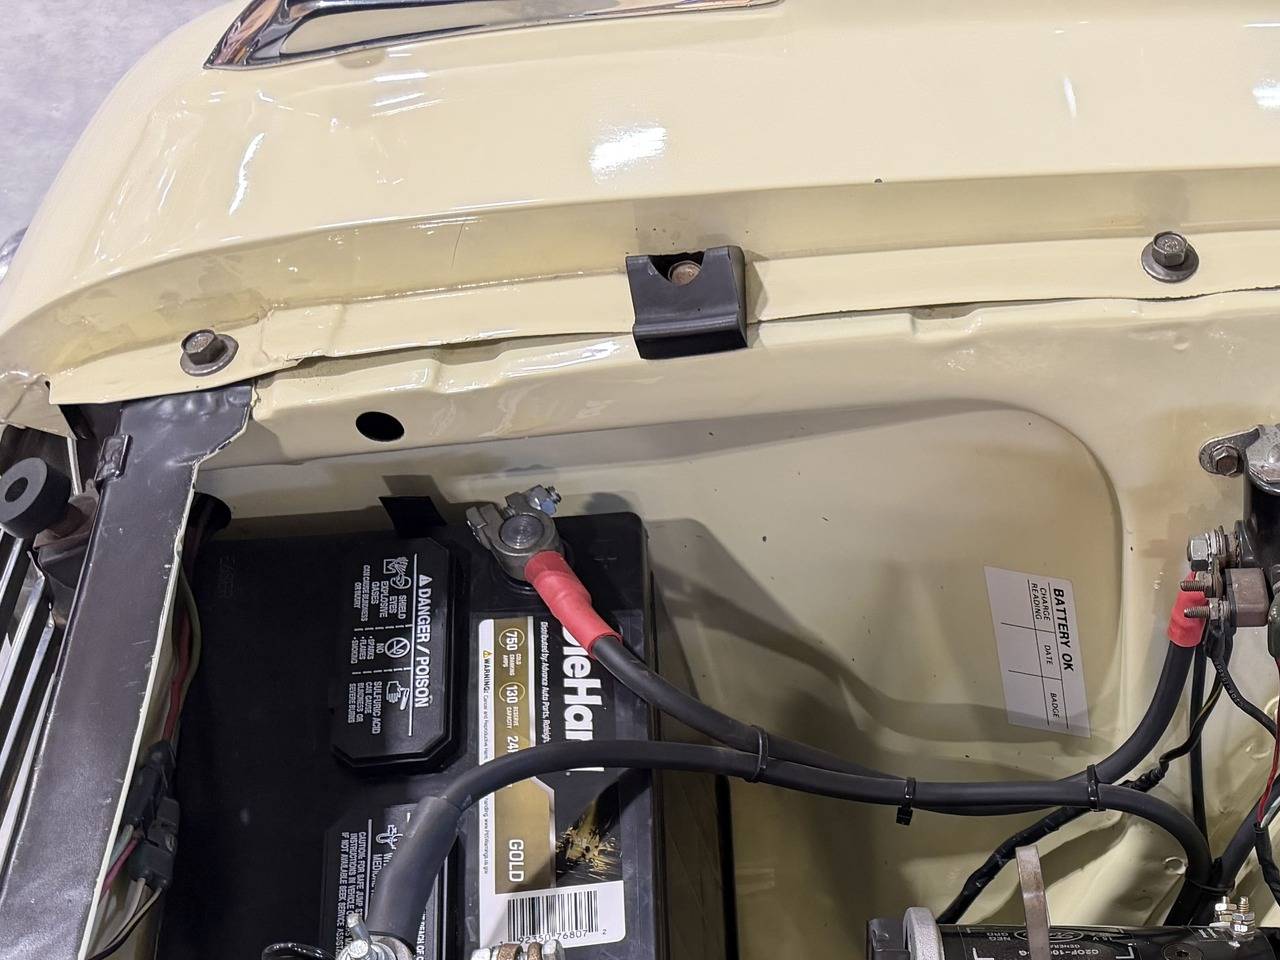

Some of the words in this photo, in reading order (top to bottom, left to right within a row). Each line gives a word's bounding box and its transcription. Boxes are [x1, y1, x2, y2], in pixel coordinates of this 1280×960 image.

[371, 581, 380, 604] GASES
[380, 580, 389, 618] EXPLOSIVE
[389, 595, 398, 614] EYES
[1031, 582, 1042, 620] READING
[1040, 588, 1050, 621] CHARGE
[398, 594, 407, 619] SHIELD
[416, 588, 431, 643] DANGER
[506, 631, 518, 650] 750
[540, 622, 549, 652] Distributed
[1053, 588, 1070, 649] BATTERY
[1062, 653, 1074, 672] OK
[376, 642, 384, 654] NO
[416, 644, 430, 655] /
[1044, 645, 1053, 665] DATE
[414, 656, 430, 708] POISON
[482, 658, 491, 693] WARNING:
[541, 662, 550, 686] Advance
[356, 682, 364, 712] BLINDNESS
[364, 694, 372, 714] CAUSE
[372, 681, 382, 716] SULFURIC
[506, 685, 518, 704] 130
[542, 686, 550, 701] Auto
[1050, 692, 1060, 718] BADGE
[372, 717, 381, 734] ACID
[341, 839, 349, 852] NOT
[349, 833, 357, 875] INSTRUCTIONS
[358, 832, 366, 860] CAUTION:
[339, 854, 348, 884] AVAILABLE
[357, 860, 366, 873] FOR
[509, 839, 524, 882] GOLD
[338, 885, 347, 901] SEEK
[356, 874, 364, 889] SAFE
[347, 885, 356, 910] VEHICLE
[355, 890, 364, 906] JUMP
[337, 902, 346, 926] SERVICE
[556, 929, 588, 940] 76807
[602, 928, 607, 936] 2
[416, 945, 425, 955] OF
